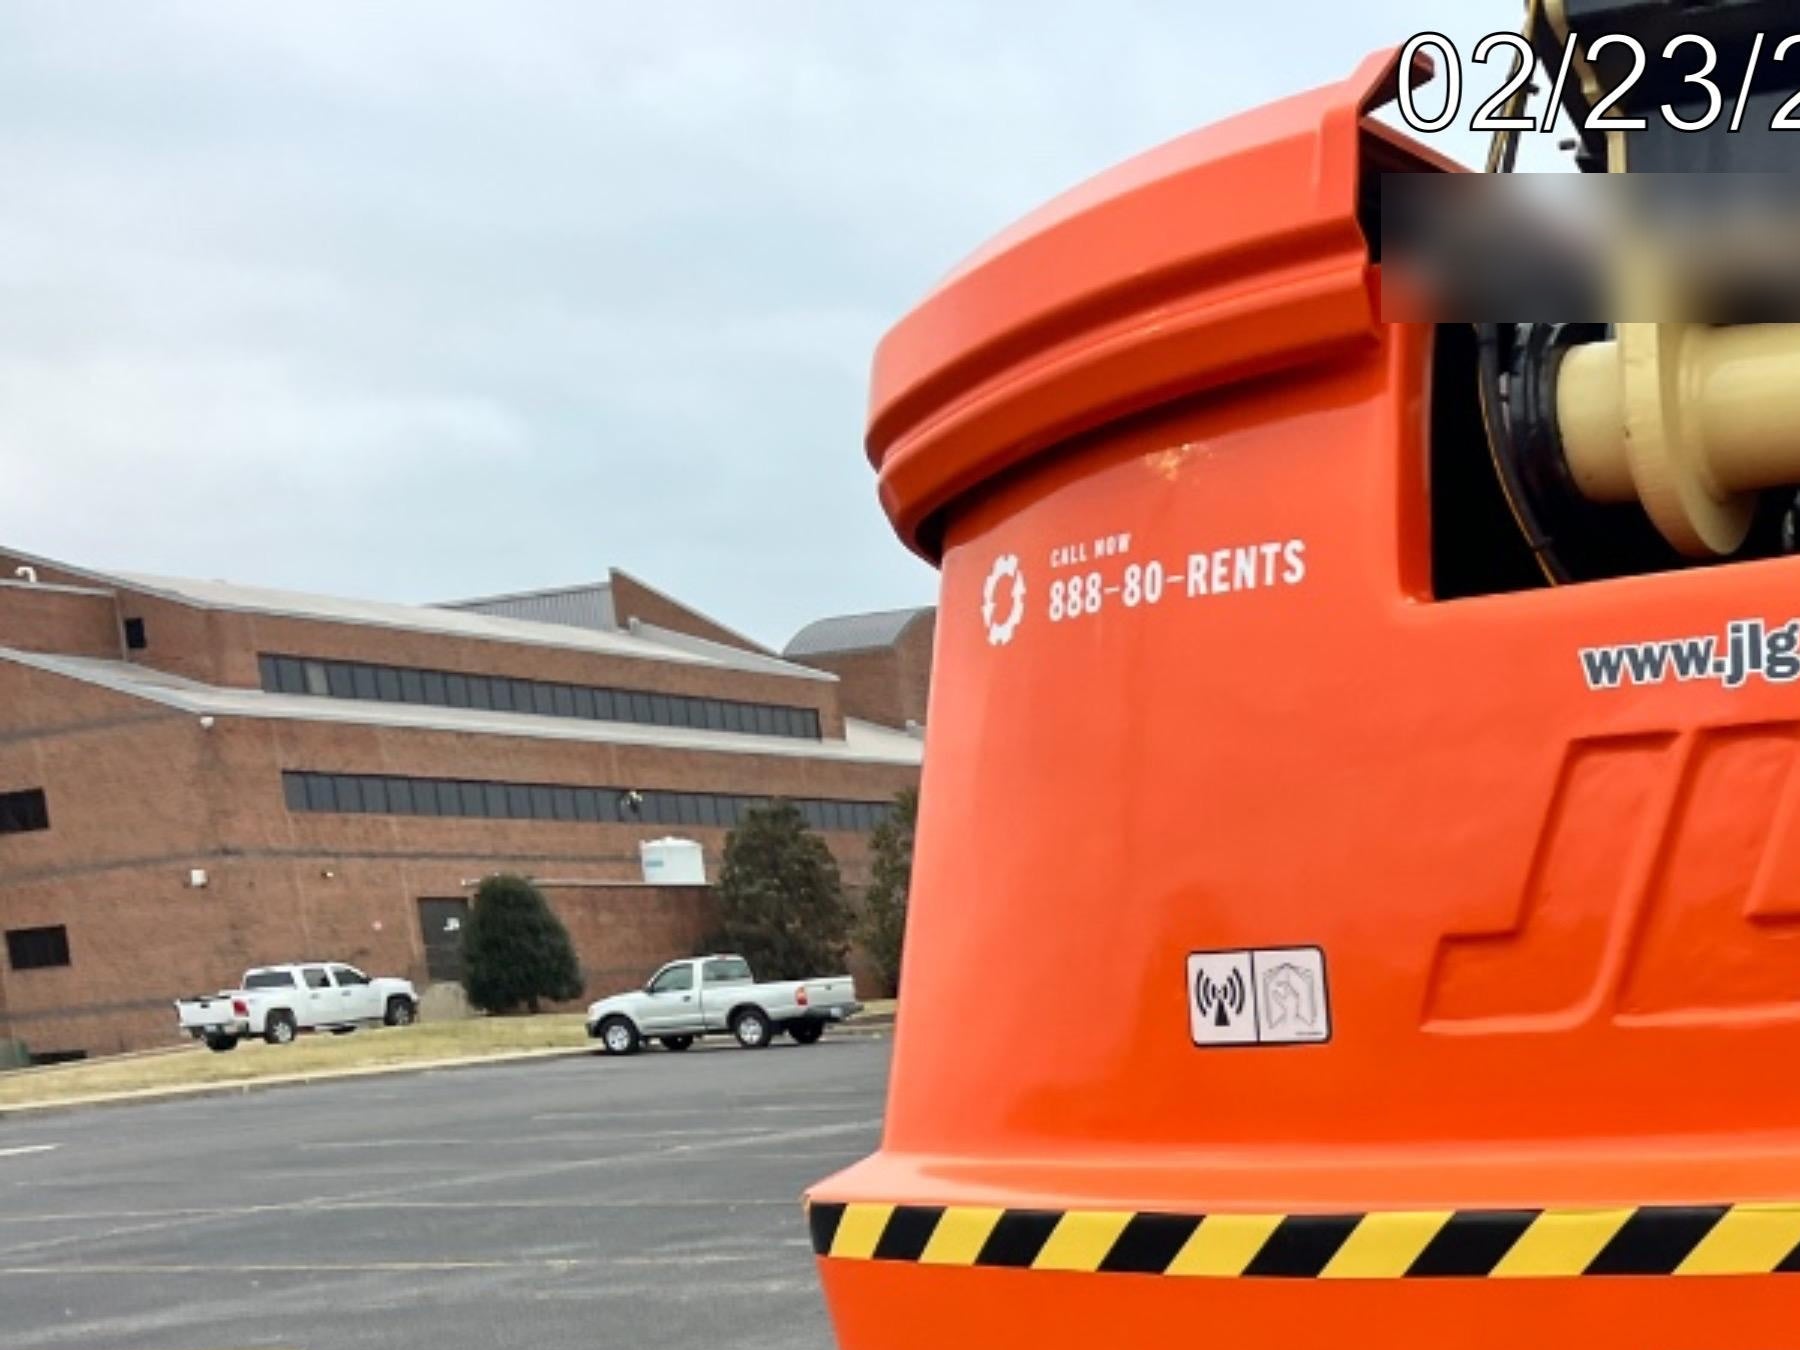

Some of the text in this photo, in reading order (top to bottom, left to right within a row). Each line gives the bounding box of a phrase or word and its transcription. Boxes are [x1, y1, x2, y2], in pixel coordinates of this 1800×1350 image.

[1050, 533, 1132, 568] CALL NOW
[1048, 539, 1306, 622] 888-80-RENTS
